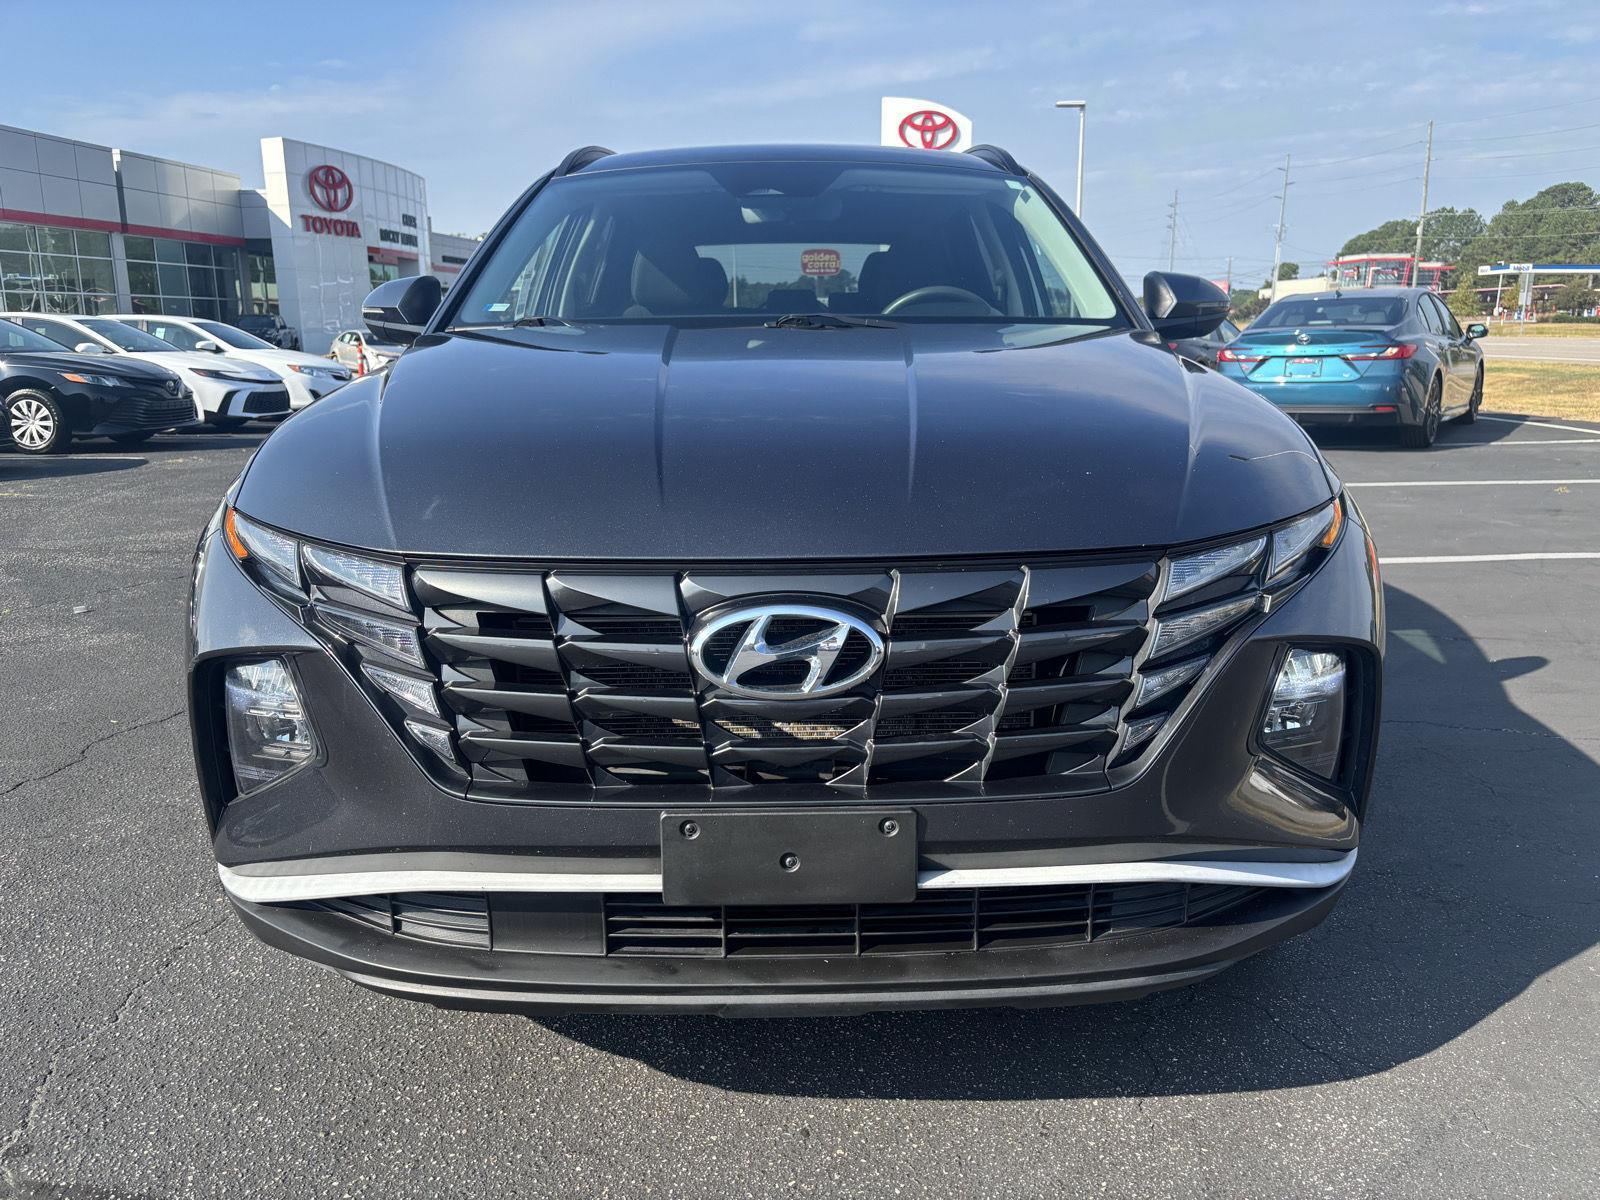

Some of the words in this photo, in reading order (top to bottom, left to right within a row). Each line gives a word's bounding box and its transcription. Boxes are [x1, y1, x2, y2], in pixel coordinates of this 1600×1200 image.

[300, 214, 361, 238] TOYOTA
[802, 252, 836, 263] golden
[808, 260, 840, 269] corral
